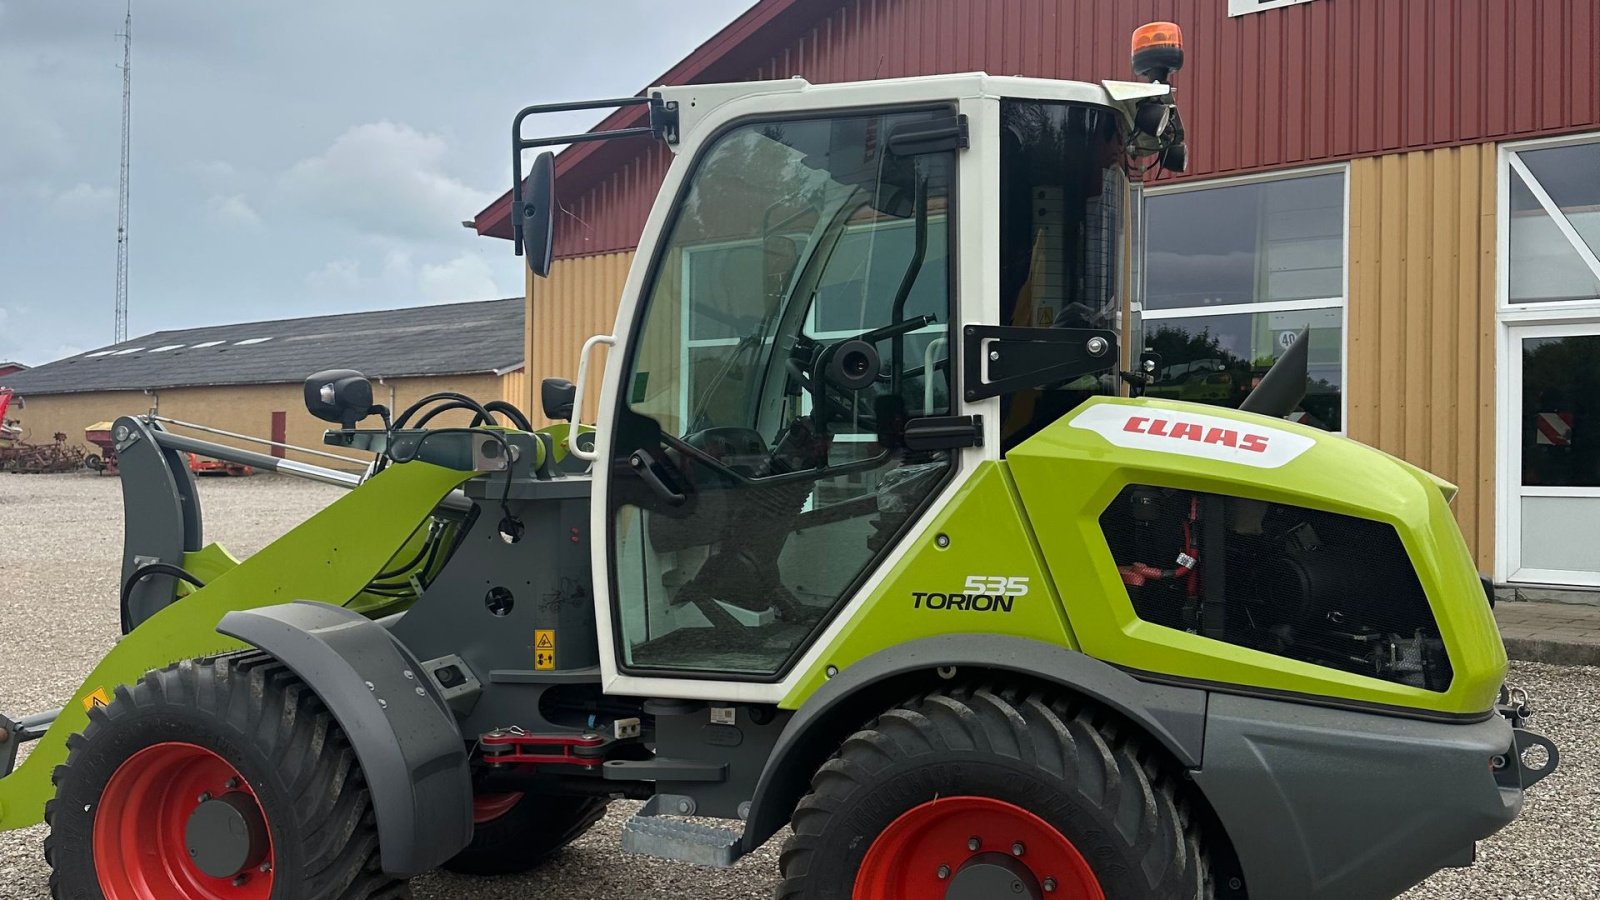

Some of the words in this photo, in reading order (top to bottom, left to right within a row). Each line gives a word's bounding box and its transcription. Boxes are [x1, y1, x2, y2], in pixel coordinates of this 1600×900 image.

[1123, 416, 1270, 453] CLAAS
[962, 576, 1030, 596] 535
[911, 592, 1015, 613] TORION
